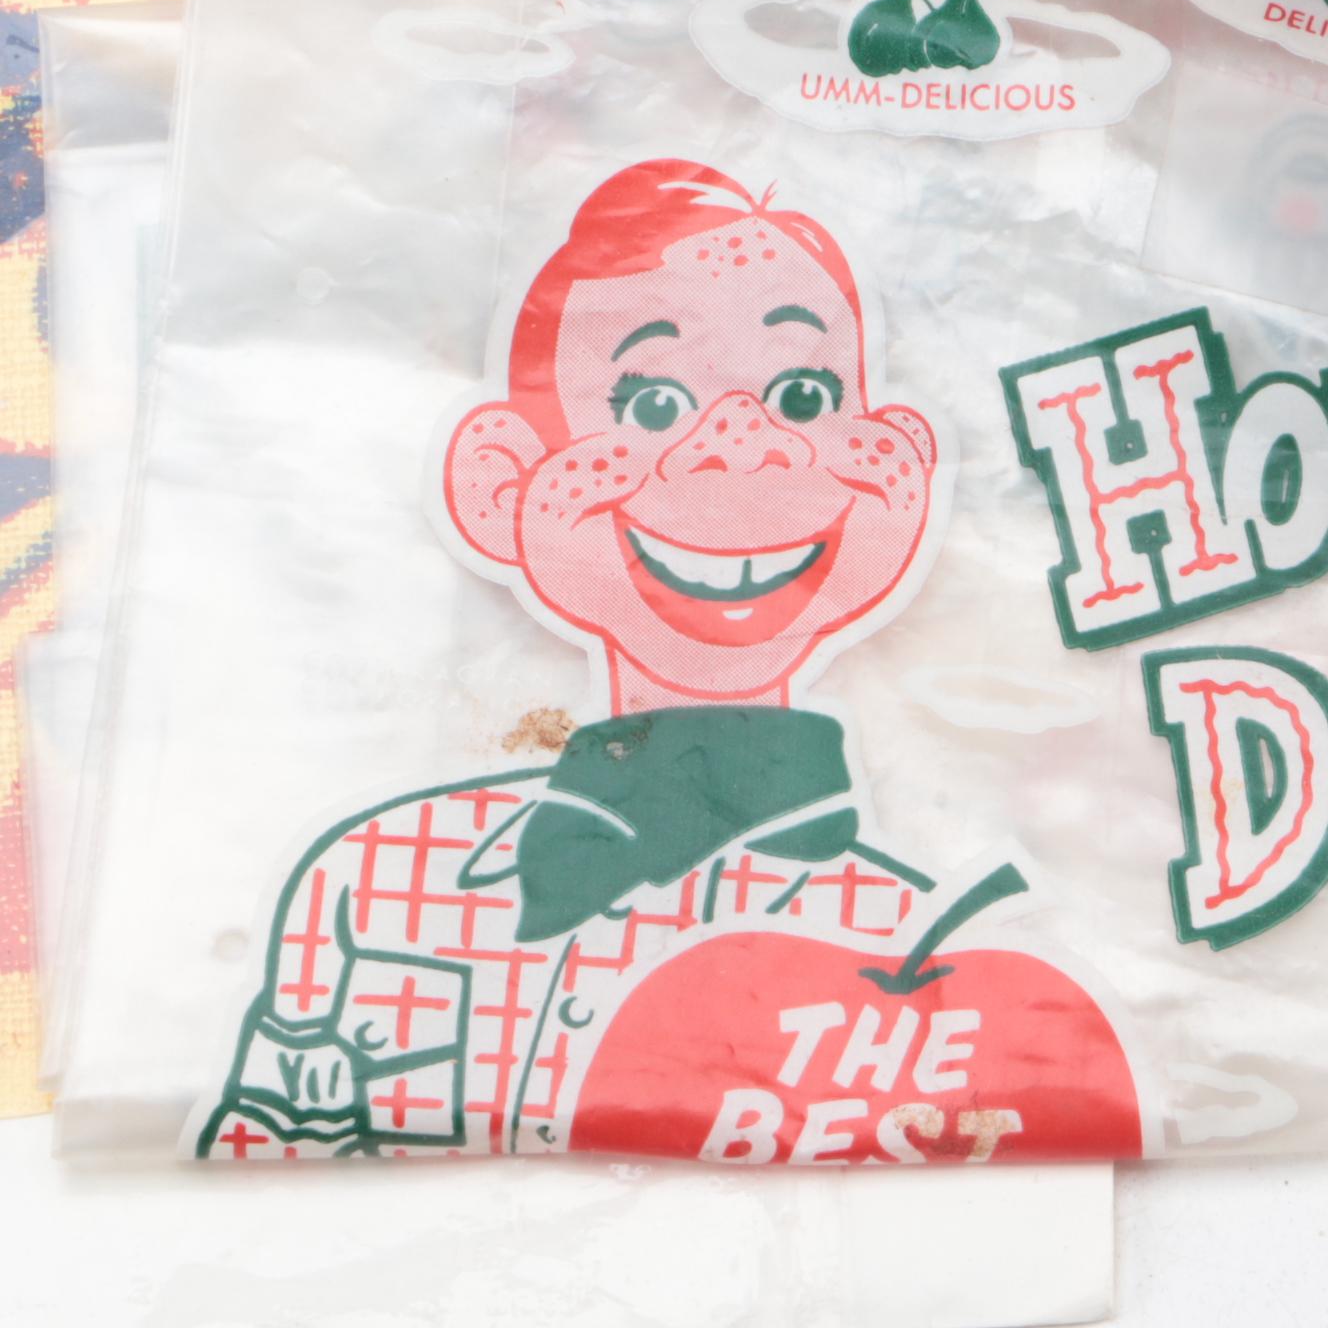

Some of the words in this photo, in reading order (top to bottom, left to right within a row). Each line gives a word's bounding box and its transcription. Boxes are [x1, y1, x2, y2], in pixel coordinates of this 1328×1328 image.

[800, 73, 1076, 112] UMM-DELICIOUS
[777, 1001, 981, 1094] THE
[698, 1088, 1024, 1165] BEST
